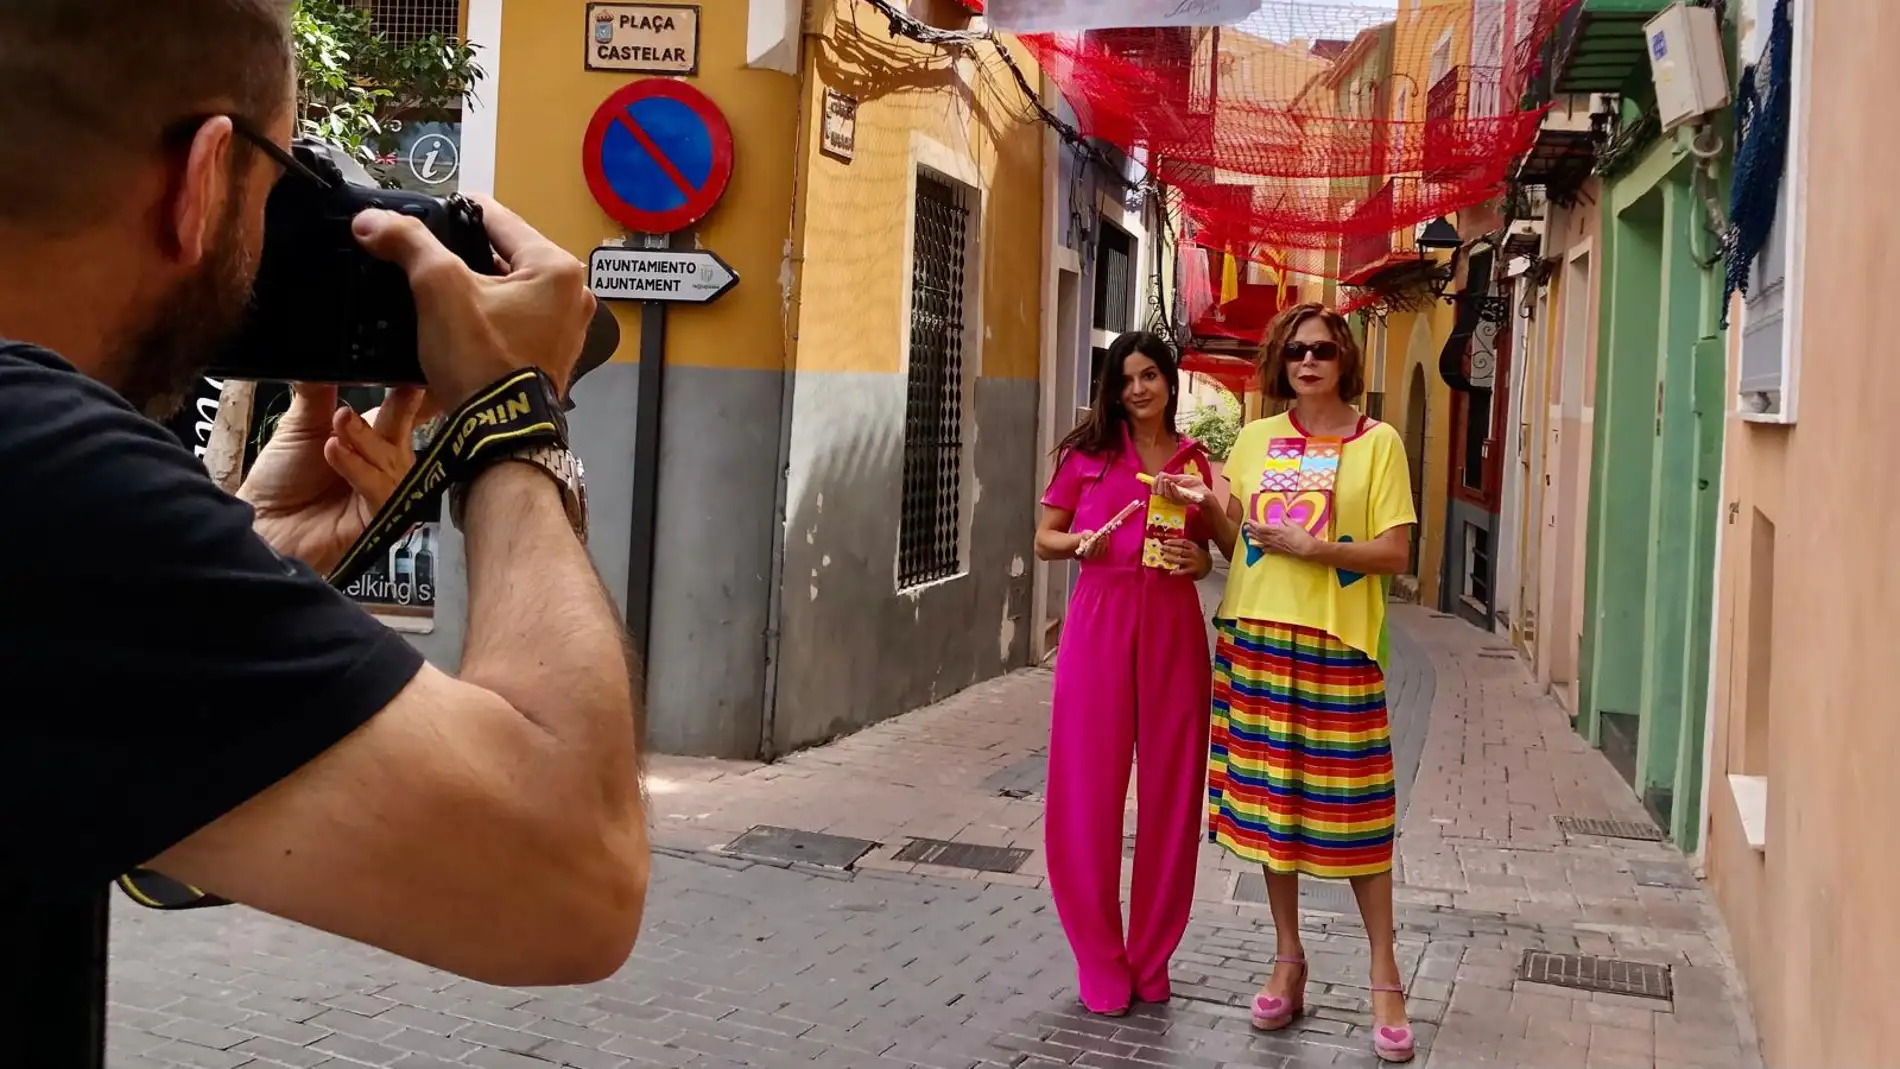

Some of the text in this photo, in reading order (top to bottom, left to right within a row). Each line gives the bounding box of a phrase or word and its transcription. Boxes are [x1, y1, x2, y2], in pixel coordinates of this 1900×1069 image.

[619, 14, 675, 34] PLAÇA
[597, 45, 686, 62] CASTELAR
[595, 258, 697, 275] AYUNTAMIENTO
[595, 276, 681, 292] AJUNTAMENT
[452, 391, 531, 456] Nikon
[342, 574, 411, 606] elking
